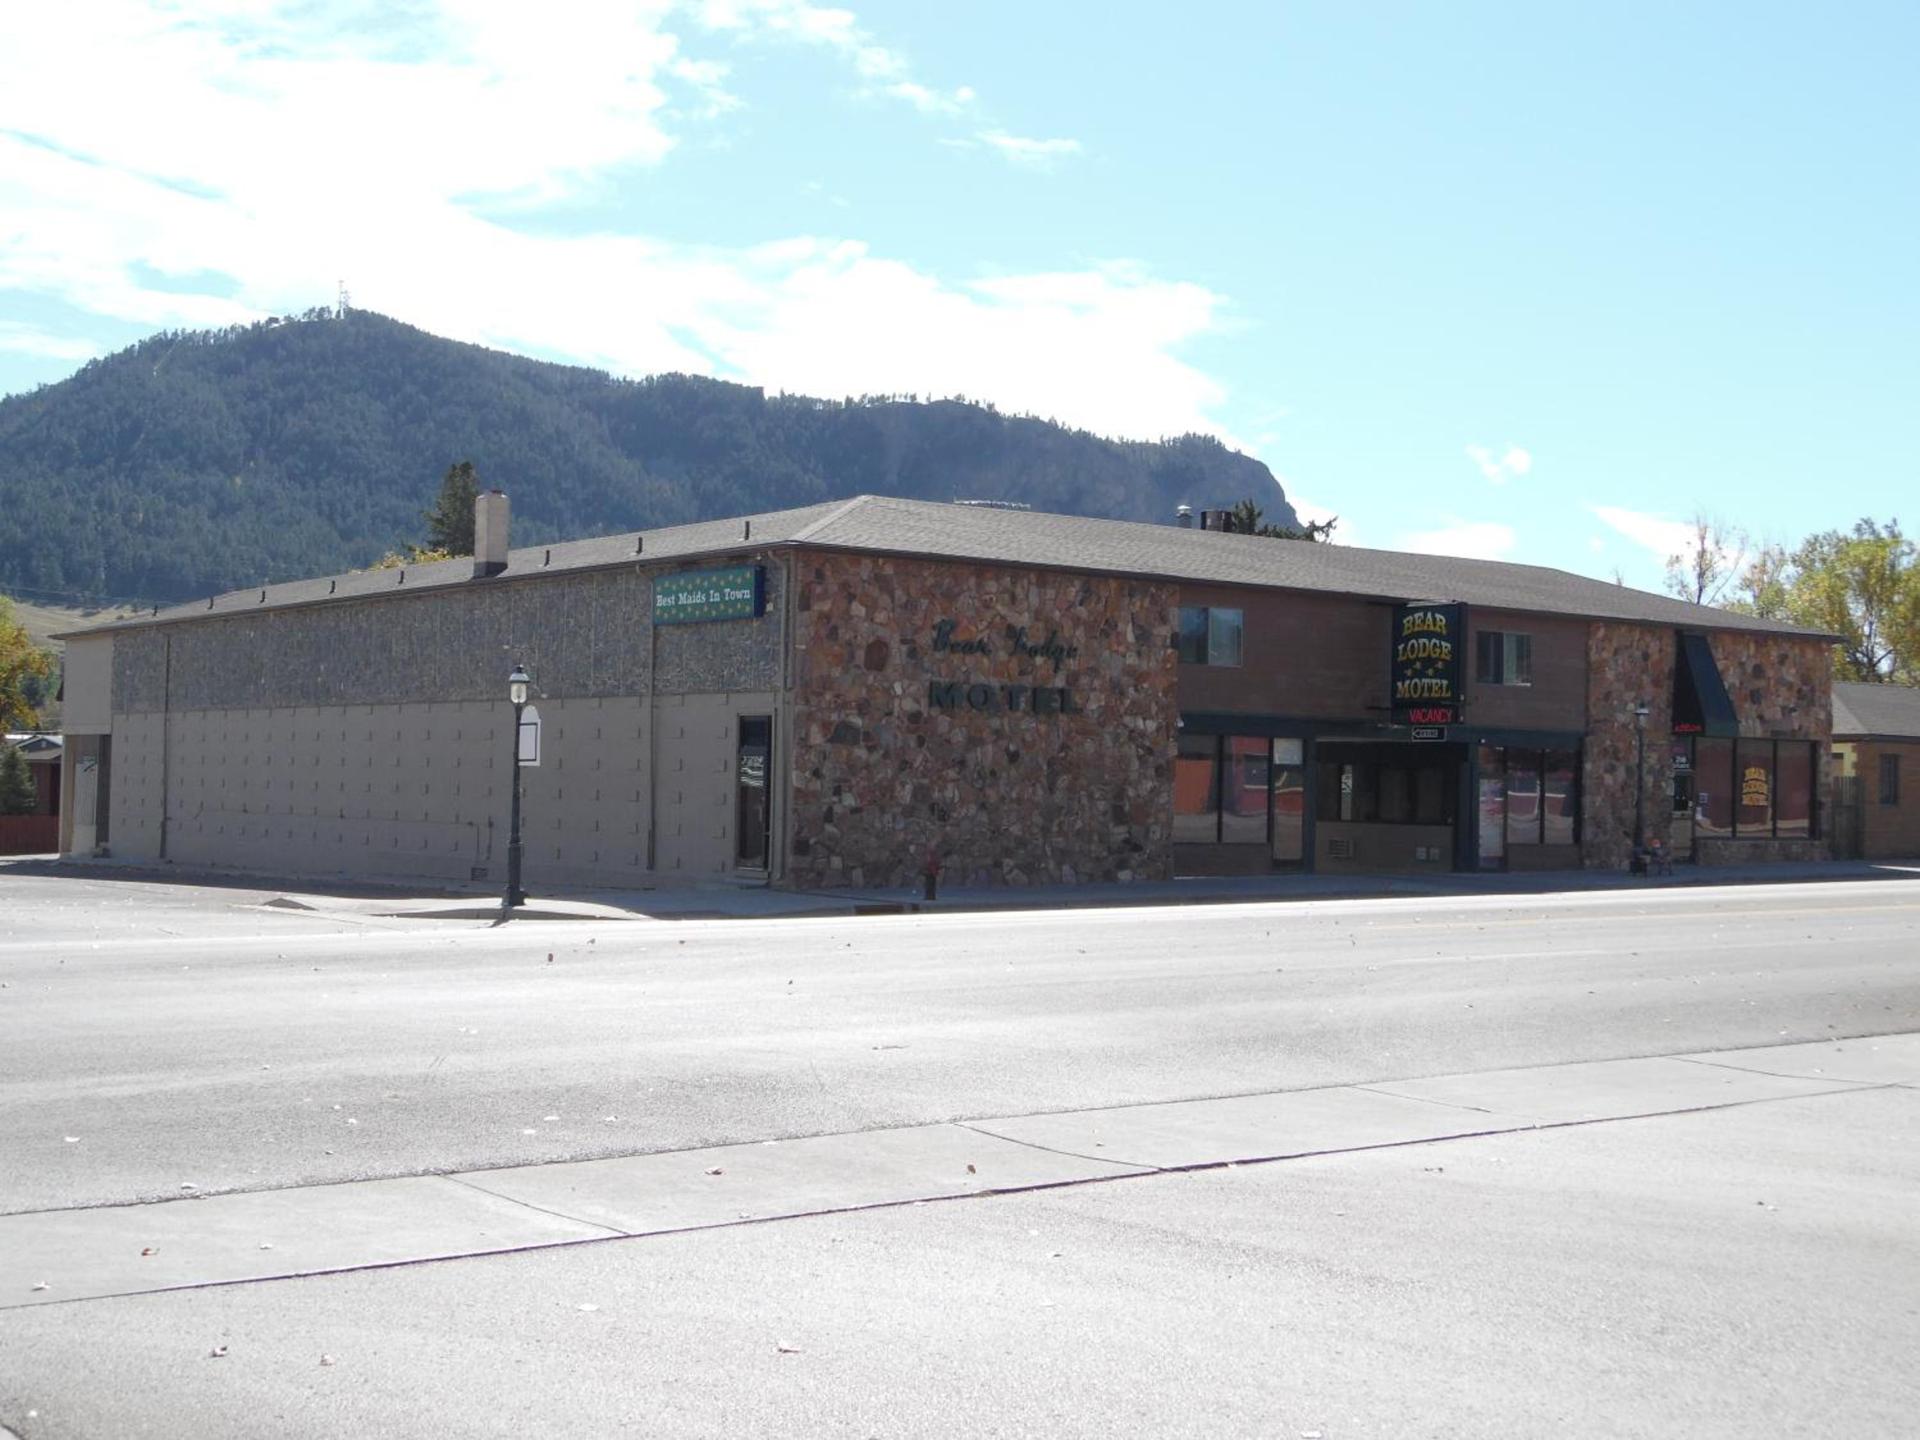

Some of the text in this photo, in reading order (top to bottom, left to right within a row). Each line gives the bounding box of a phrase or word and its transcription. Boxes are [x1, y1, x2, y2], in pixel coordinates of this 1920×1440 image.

[656, 588, 751, 607] Best Maids In Town
[1402, 611, 1446, 636] BEAR
[1397, 638, 1452, 661] LODGE
[929, 682, 1083, 714] MOTEL
[1396, 678, 1451, 698] MOTEL
[1409, 708, 1453, 723] VACANCY
